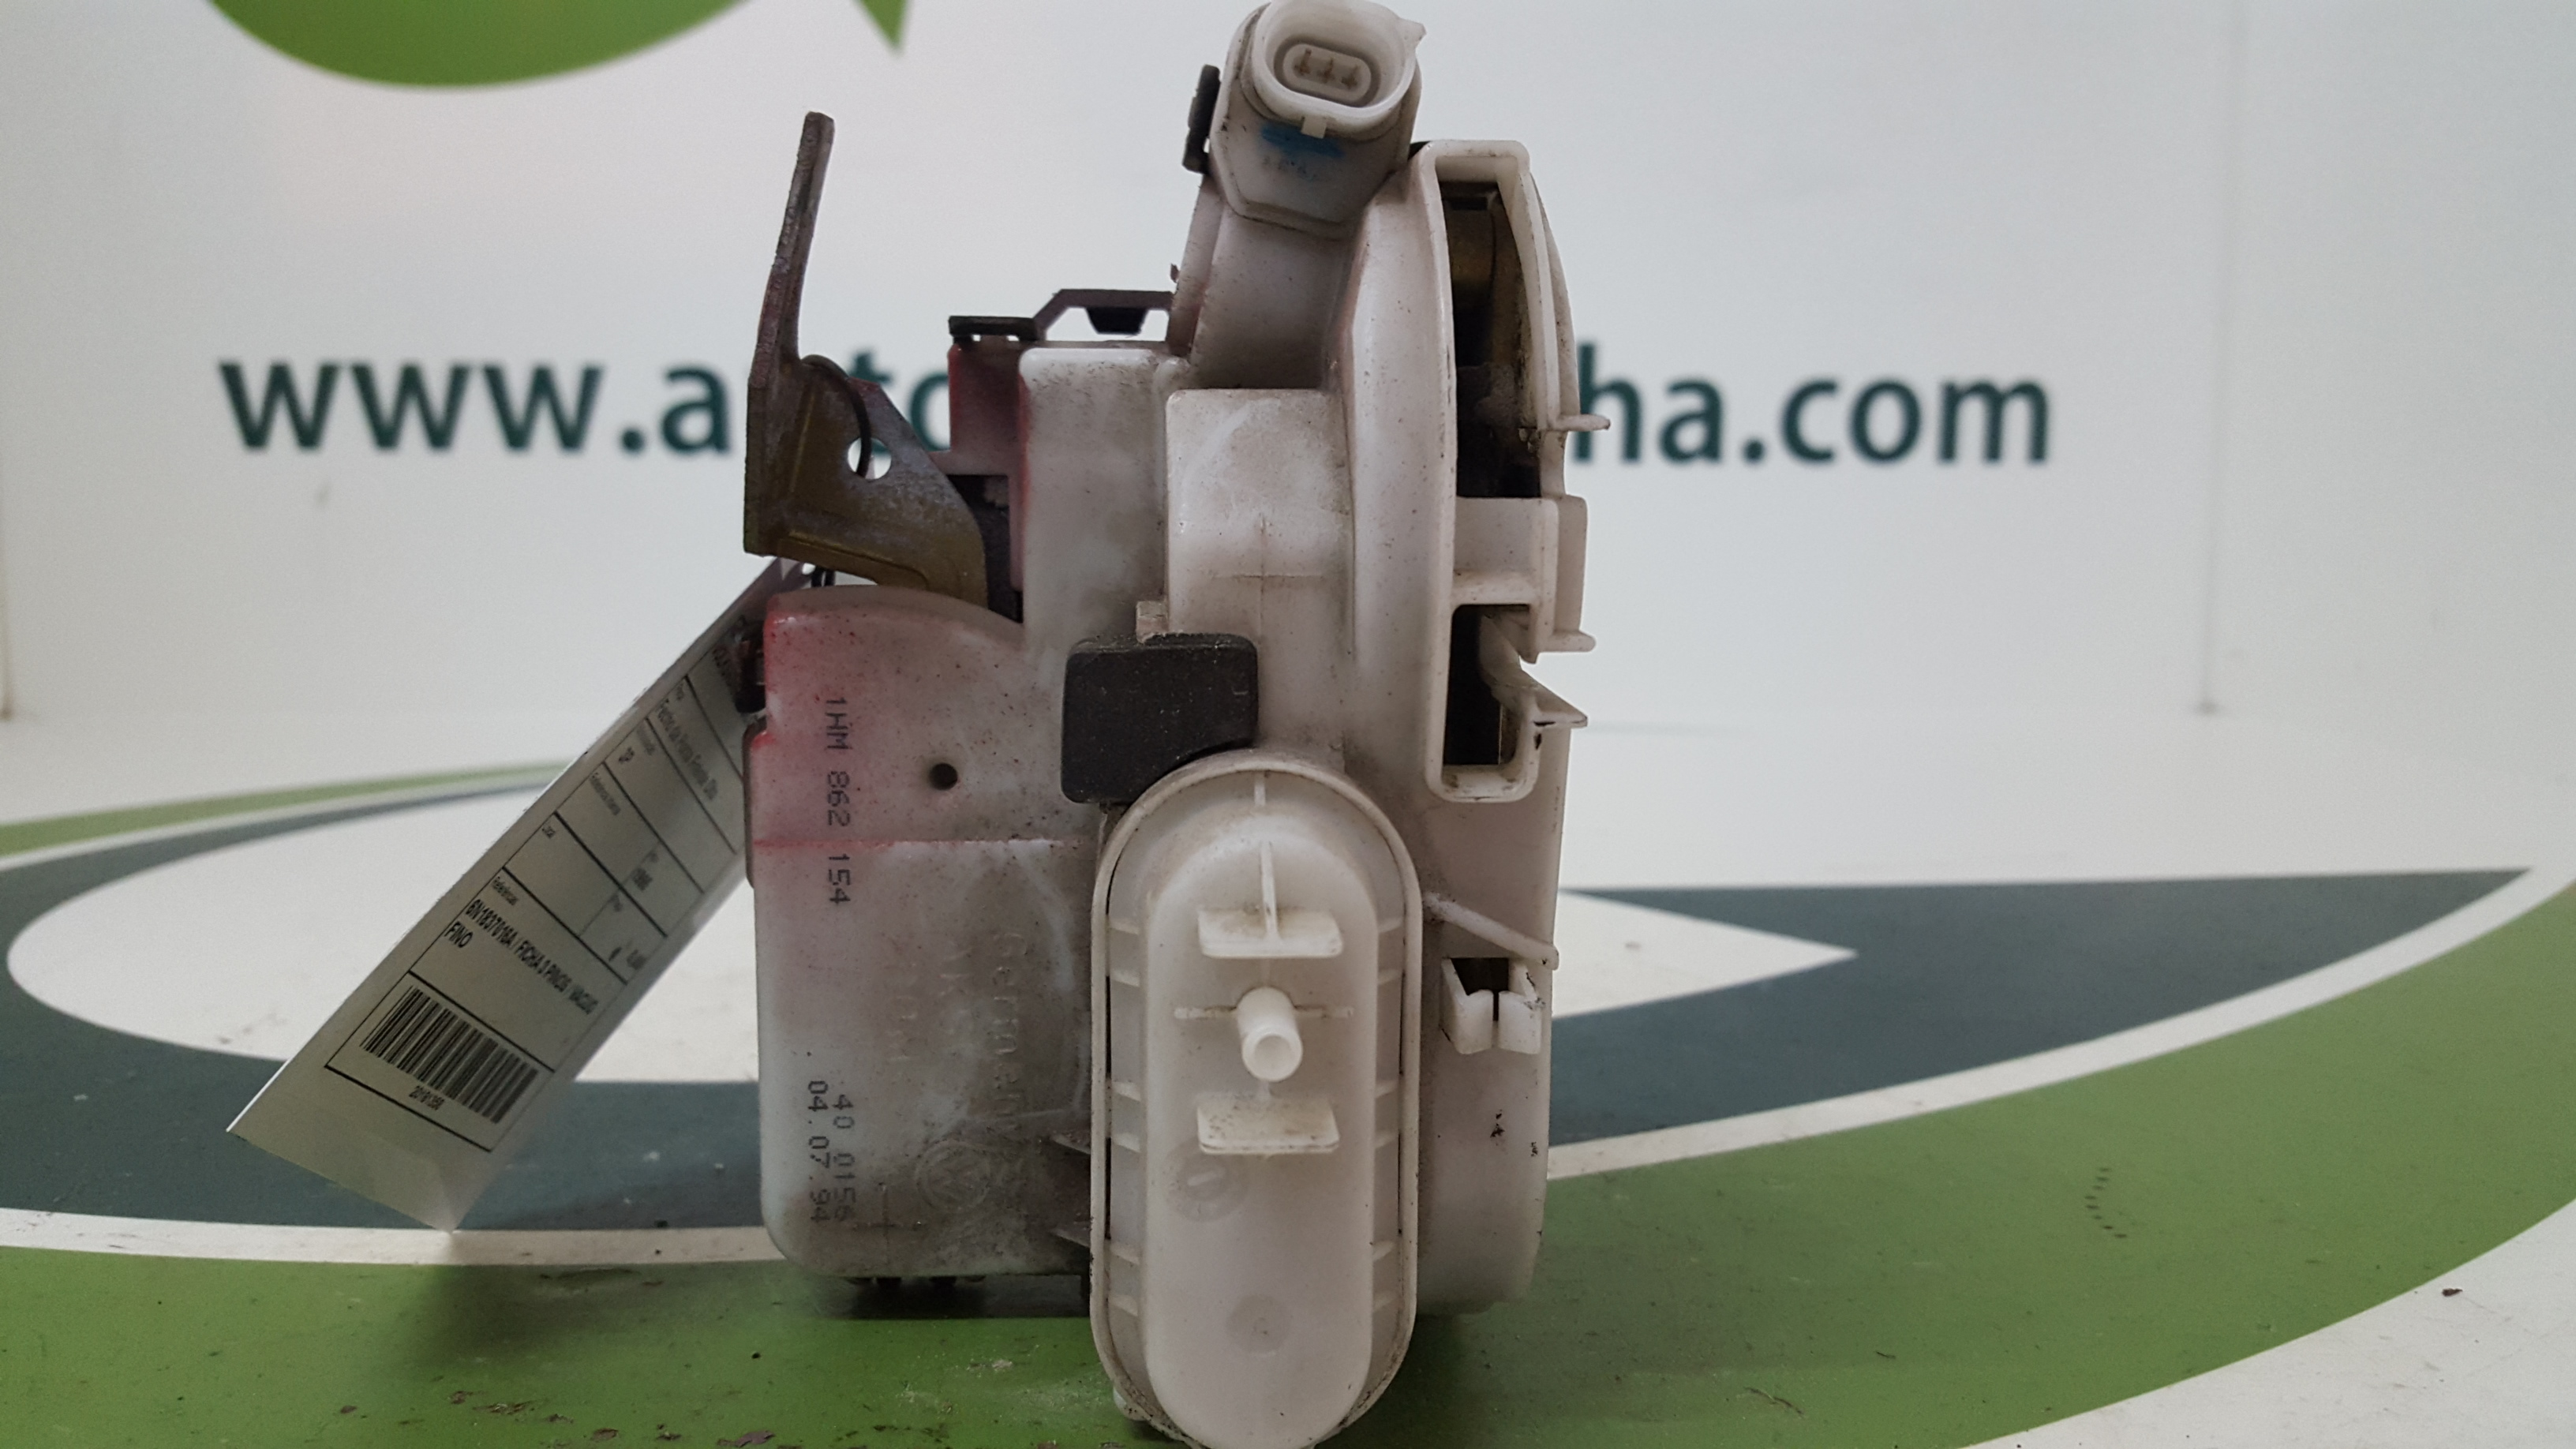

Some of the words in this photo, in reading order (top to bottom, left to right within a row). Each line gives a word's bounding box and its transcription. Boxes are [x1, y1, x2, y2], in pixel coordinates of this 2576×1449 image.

[826, 697, 853, 751] 1HM
[827, 771, 851, 827] 862
[828, 853, 852, 905] 154
[444, 921, 474, 949] FINO
[833, 1094, 856, 1129] 40
